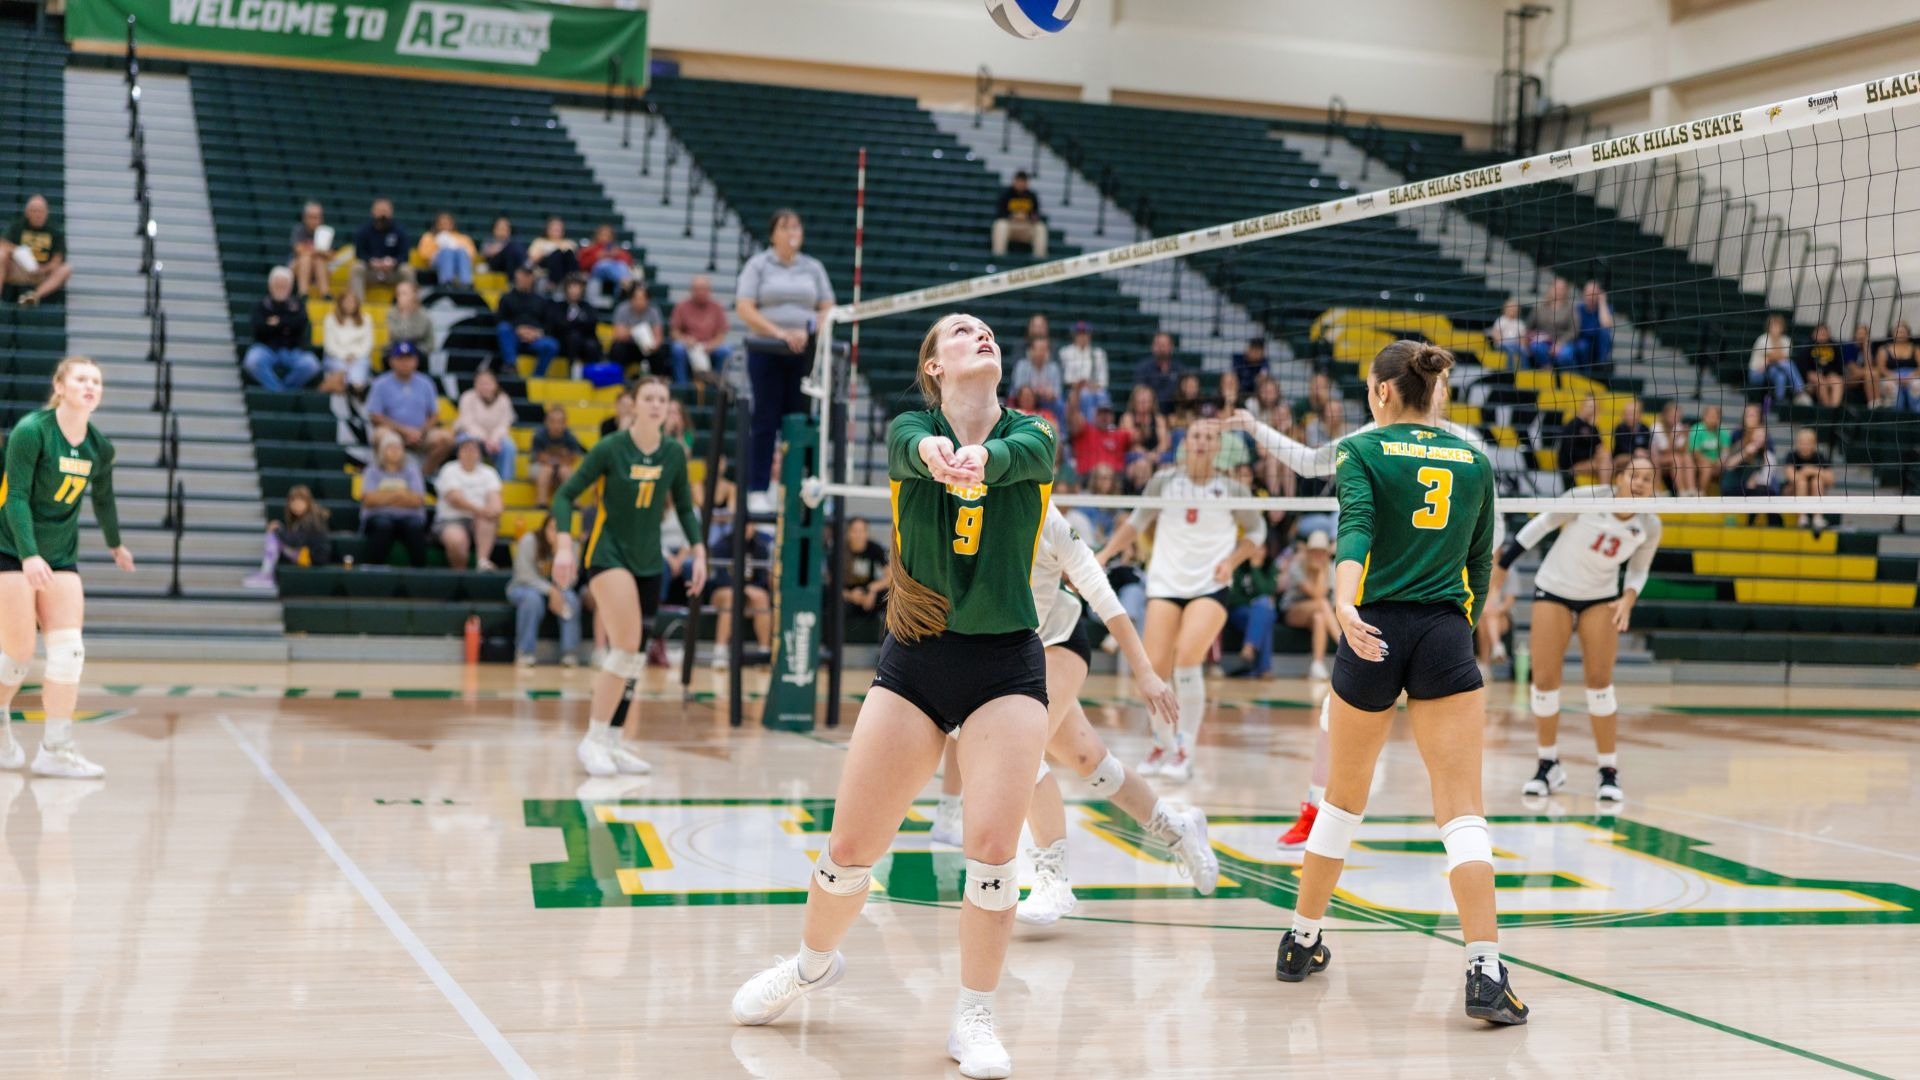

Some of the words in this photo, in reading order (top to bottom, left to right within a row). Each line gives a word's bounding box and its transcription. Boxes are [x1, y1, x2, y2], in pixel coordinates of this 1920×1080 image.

[169, 0, 337, 37] WELCOME
[344, 6, 388, 41] TO
[409, 10, 465, 48] A2
[1866, 71, 1920, 103] BLAC
[1592, 135, 1641, 162] BLACK
[1643, 124, 1689, 151] HILLS
[1692, 112, 1744, 140] STATE
[1389, 182, 1426, 205] BLACK
[1428, 175, 1462, 197] HILLS
[1465, 166, 1502, 189] STATE
[1232, 220, 1261, 238] BLACK
[1263, 213, 1290, 231] HILLS
[1291, 206, 1321, 225] STATE
[1380, 441, 1427, 458] YELLOW
[1427, 446, 1474, 464] JACKETS
[54, 475, 87, 504] 17
[635, 481, 656, 509] 11
[1412, 466, 1453, 530] 3
[953, 506, 984, 556] 9
[1590, 531, 1622, 557] 13
